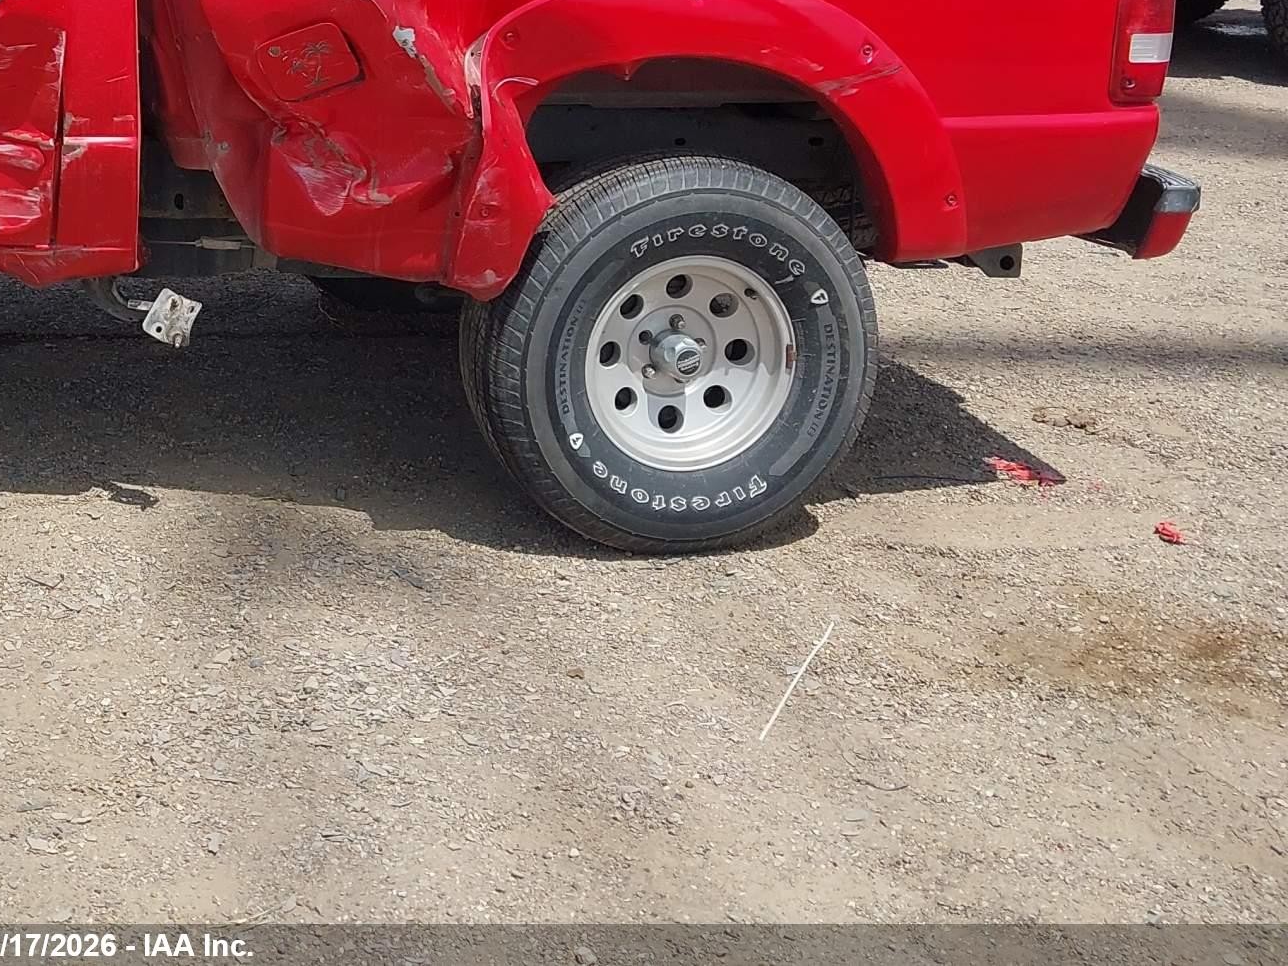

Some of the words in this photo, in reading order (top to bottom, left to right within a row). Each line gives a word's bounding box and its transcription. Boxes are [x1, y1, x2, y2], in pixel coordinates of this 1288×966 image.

[630, 223, 806, 276] Firestone
[559, 317, 579, 415] DESTINATION
[815, 323, 836, 420] DESTINATION
[592, 460, 768, 512] Firestone
